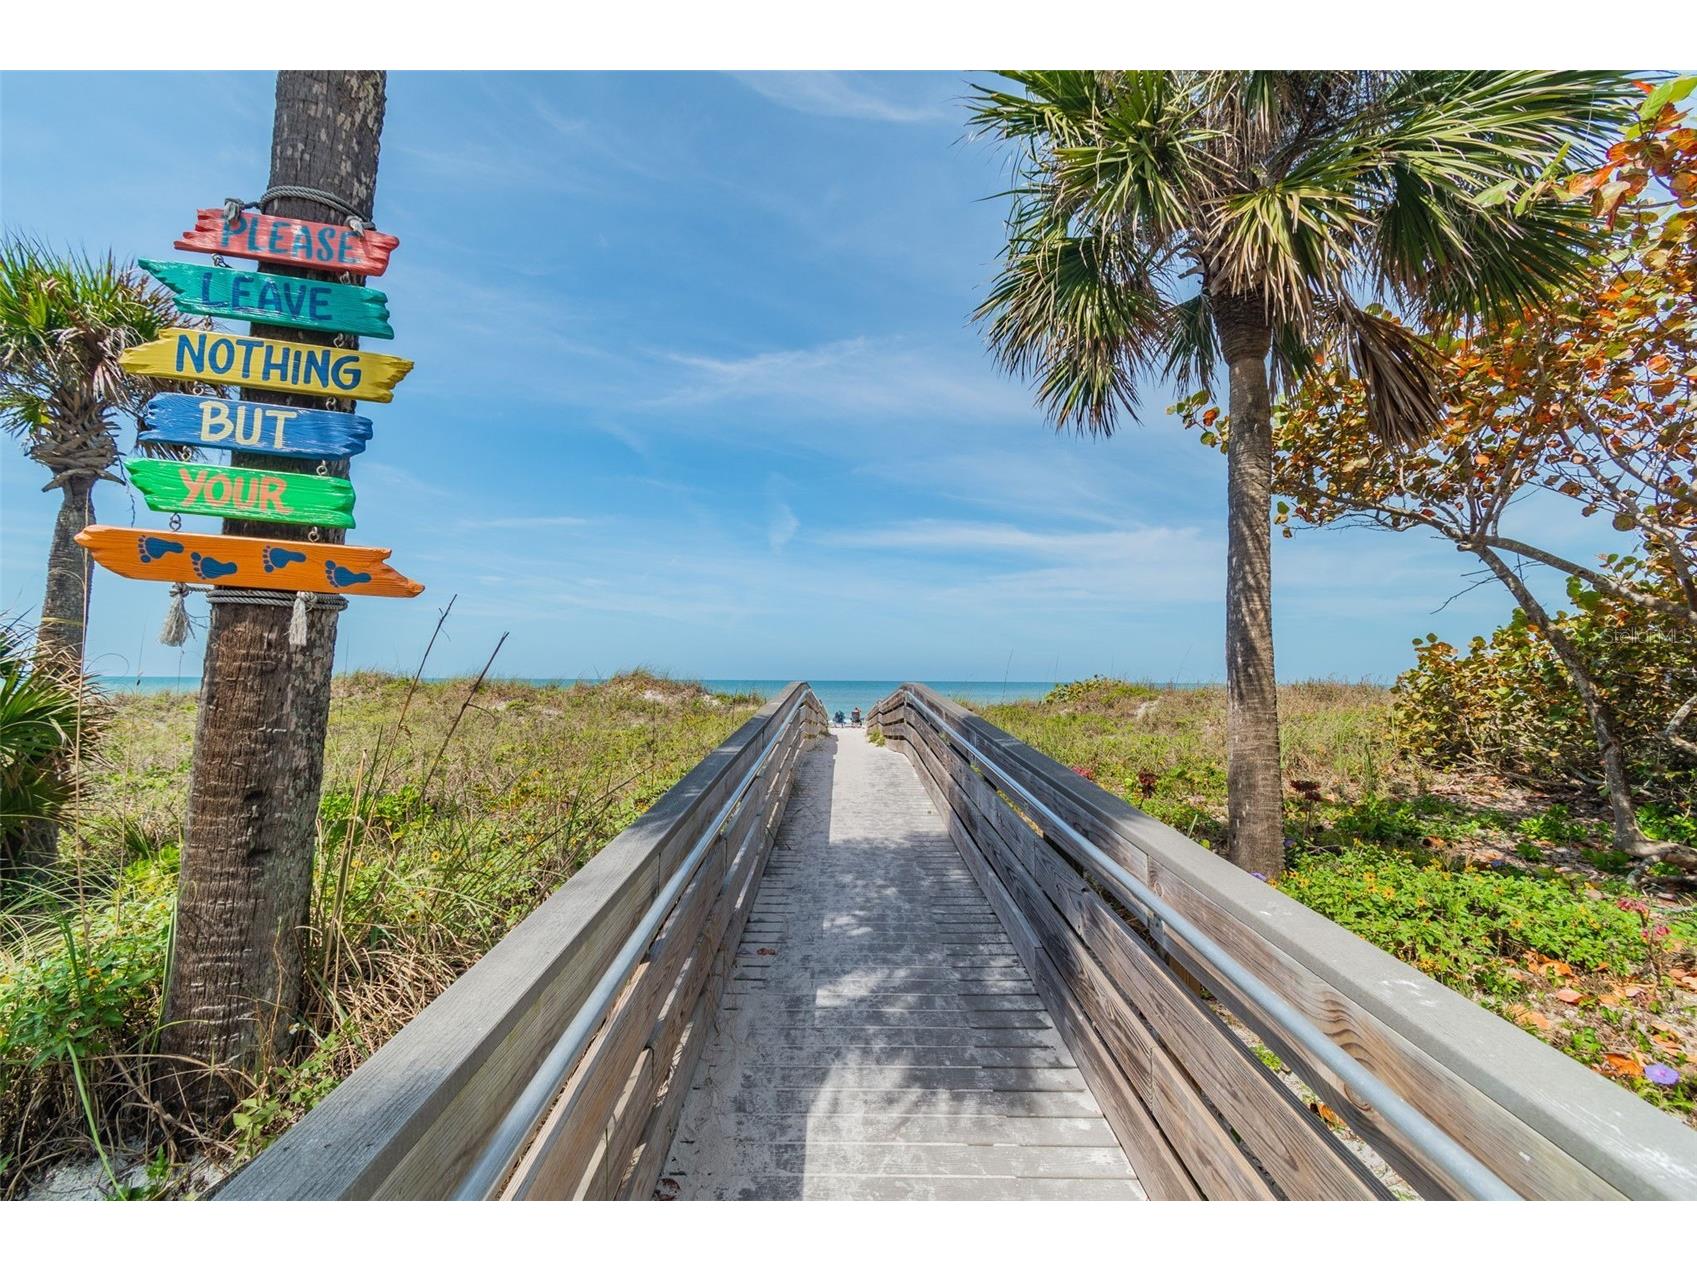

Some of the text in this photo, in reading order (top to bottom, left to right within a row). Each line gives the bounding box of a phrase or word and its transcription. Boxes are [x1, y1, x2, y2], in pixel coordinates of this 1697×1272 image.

[220, 215, 362, 264] PLEASE
[202, 272, 332, 320] LEAVE
[175, 334, 362, 390] NOTHING
[199, 401, 298, 449] BUT
[179, 468, 294, 514] YOUR
